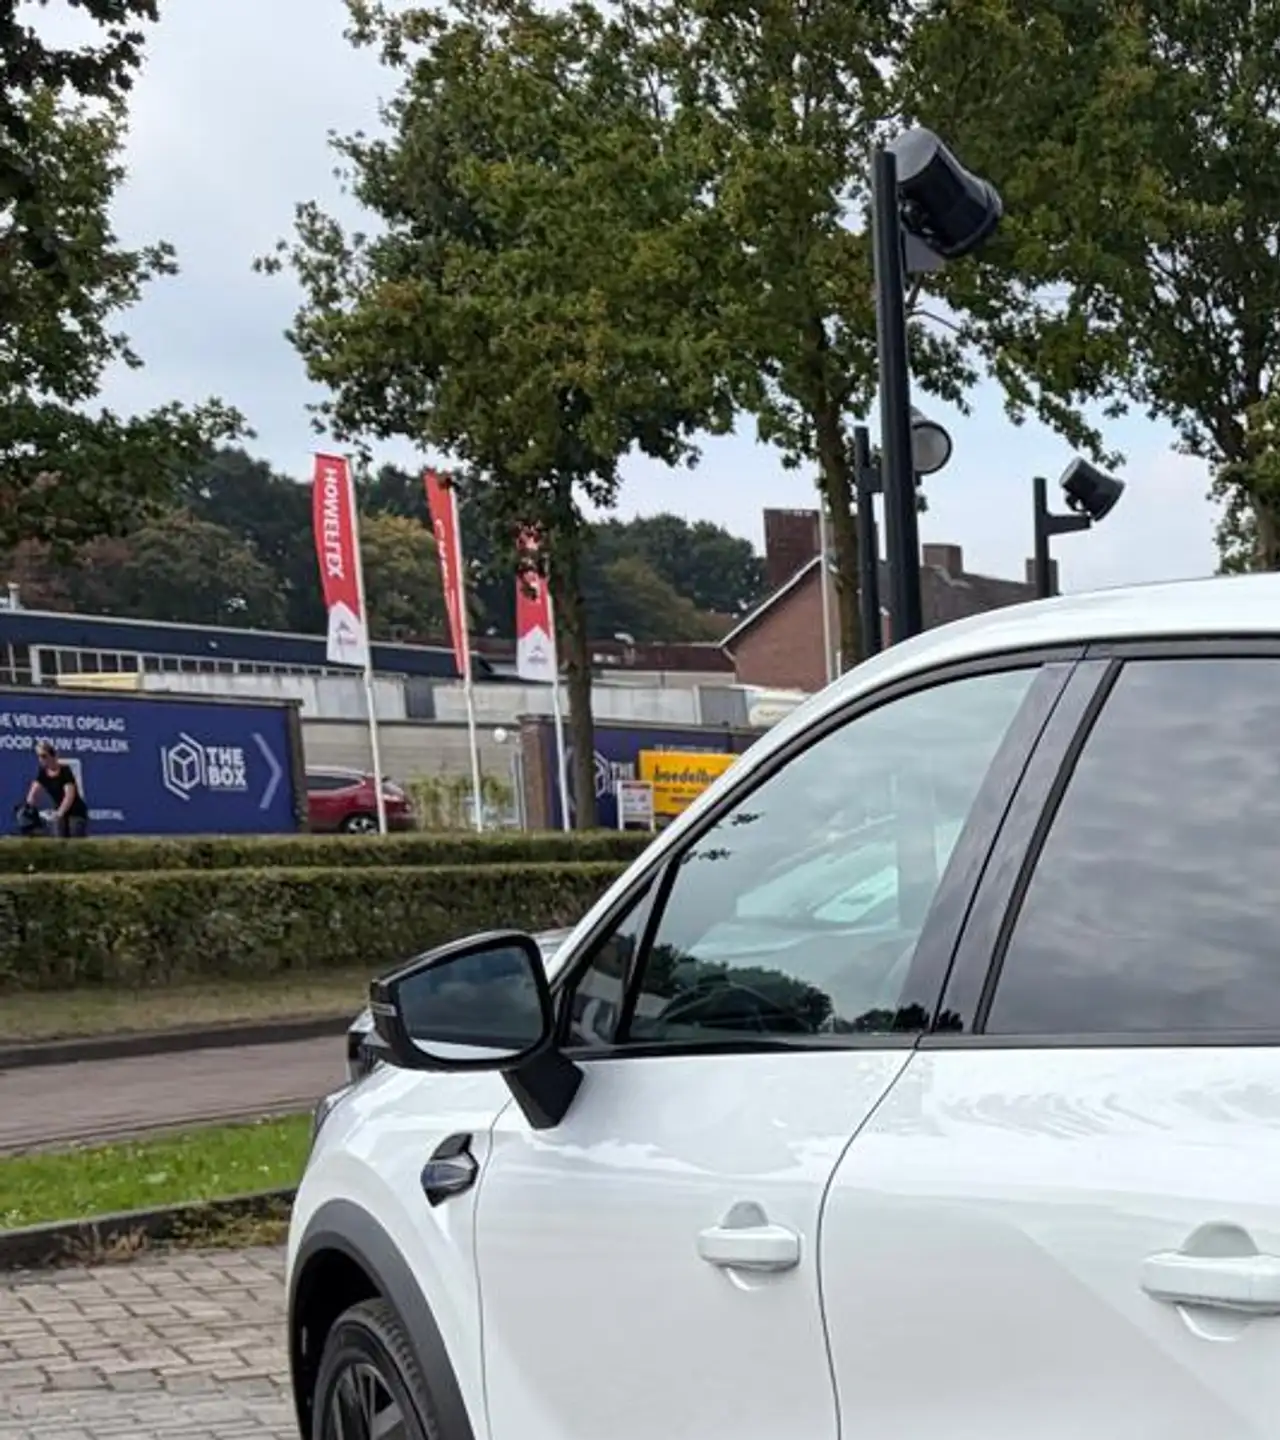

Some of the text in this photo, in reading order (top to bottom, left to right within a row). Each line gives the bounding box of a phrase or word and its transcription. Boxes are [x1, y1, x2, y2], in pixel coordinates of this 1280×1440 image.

[76, 715, 126, 732] OPSLAG
[206, 746, 244, 767] THE
[208, 765, 248, 787] BOX
